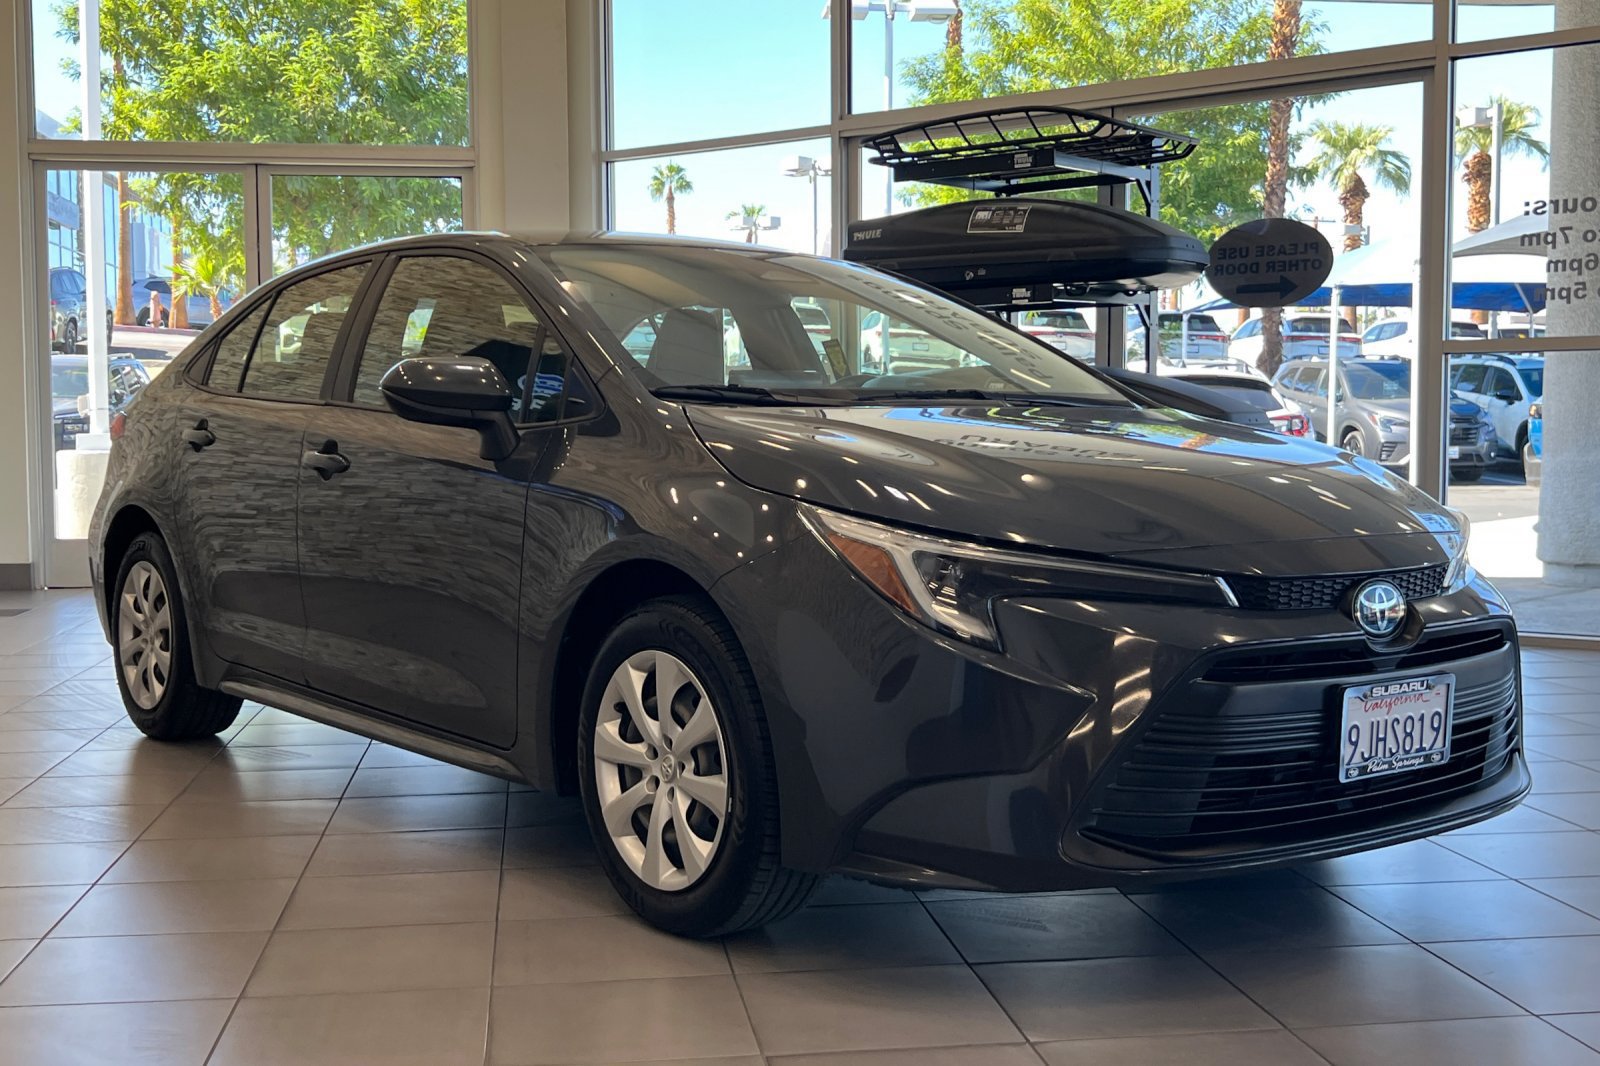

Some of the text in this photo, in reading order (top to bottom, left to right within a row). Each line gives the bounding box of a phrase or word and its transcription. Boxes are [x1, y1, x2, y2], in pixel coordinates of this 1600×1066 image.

[853, 229, 882, 241] THULE
[1372, 680, 1428, 697] SUBARU
[1364, 693, 1430, 715] California
[1346, 710, 1443, 766] 9JHS819
[1367, 755, 1424, 773] Palm Springs
